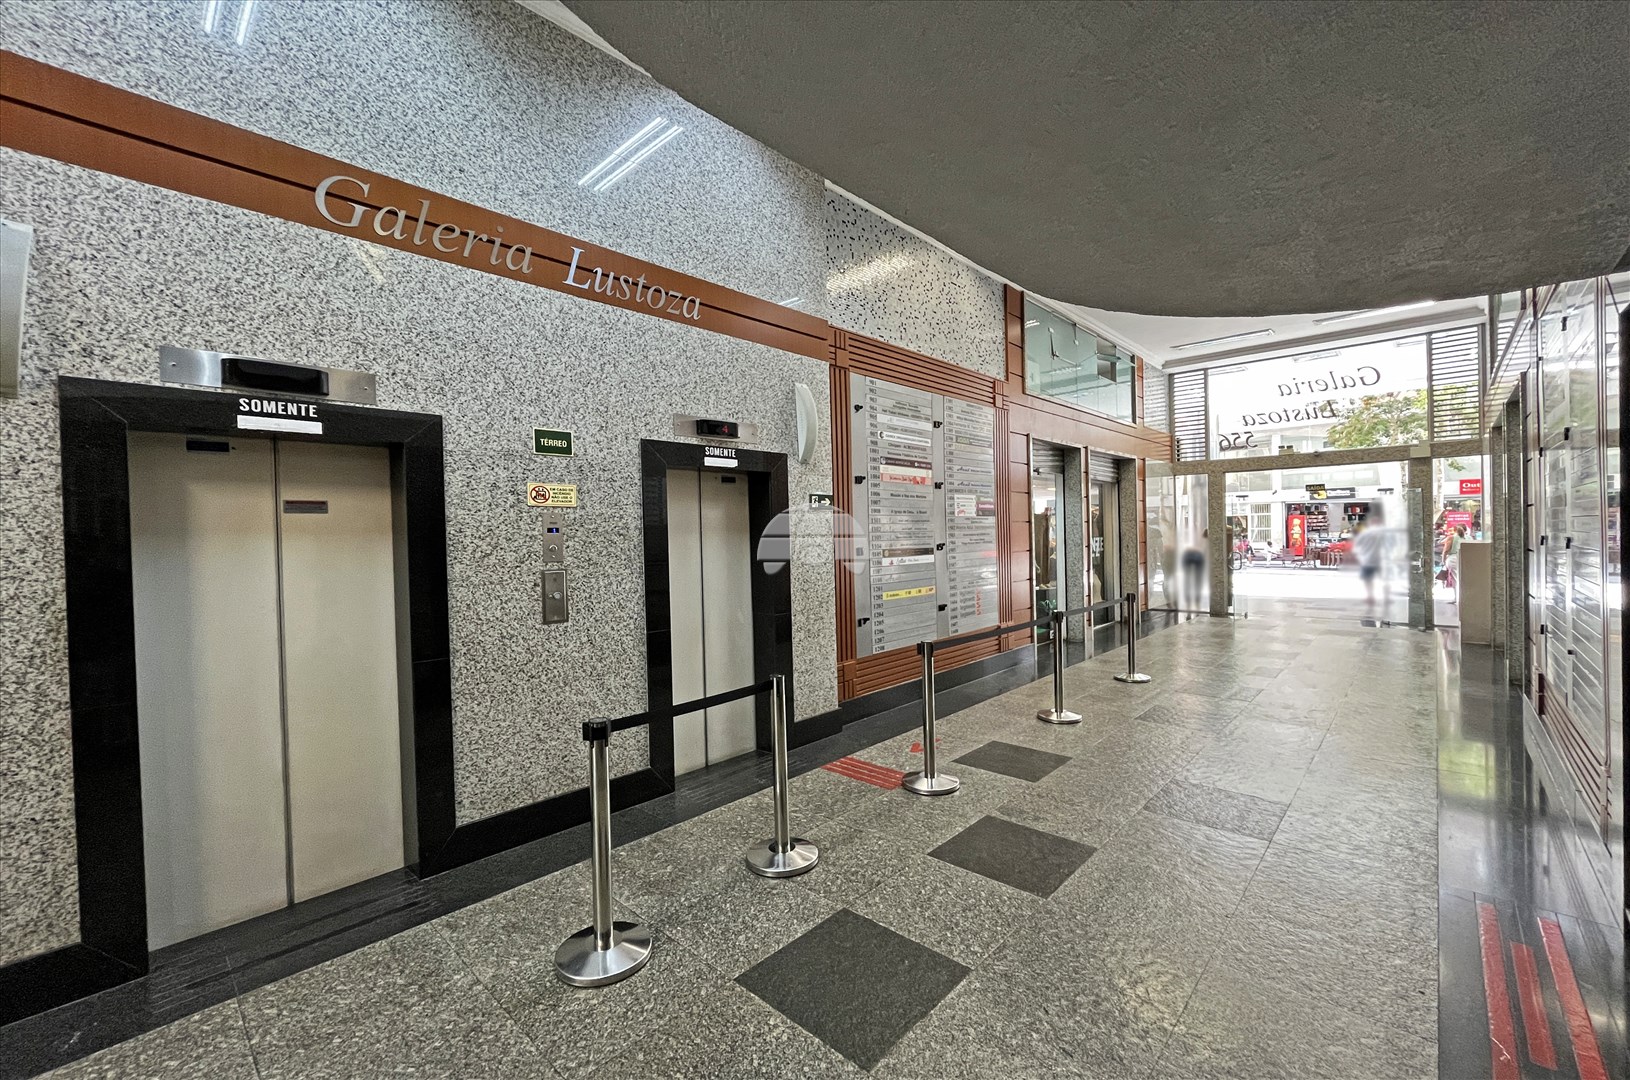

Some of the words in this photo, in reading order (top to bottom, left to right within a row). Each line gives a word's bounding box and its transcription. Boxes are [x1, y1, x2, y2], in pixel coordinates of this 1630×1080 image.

[314, 173, 534, 275] Galeria
[562, 246, 702, 321] Lustoza
[238, 398, 318, 418] SOMENTE
[540, 438, 567, 448] TÉRREO
[705, 447, 736, 457] SOMENTE
